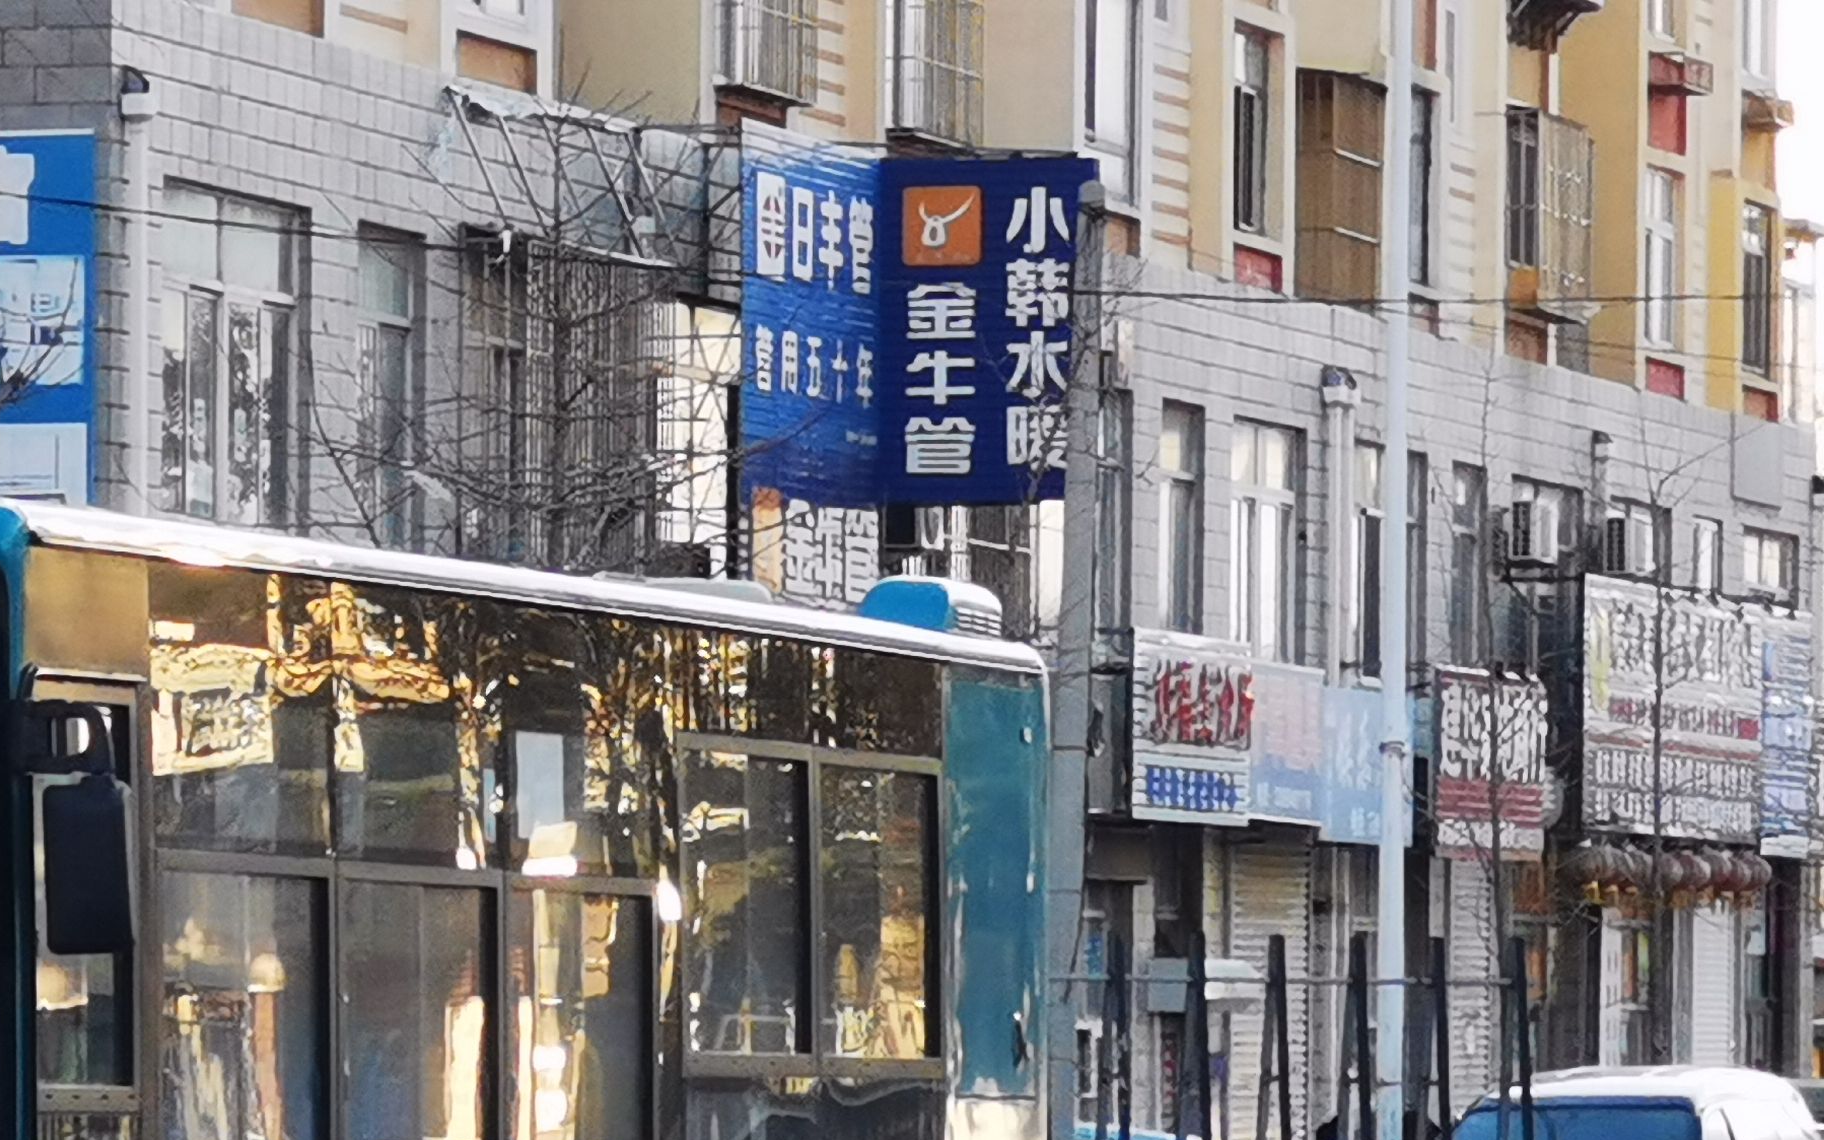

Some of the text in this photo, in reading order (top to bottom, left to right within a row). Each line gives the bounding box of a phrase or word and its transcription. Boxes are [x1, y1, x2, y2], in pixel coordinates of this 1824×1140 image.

[905, 282, 976, 474] 金牛管
[1006, 187, 1069, 470] 小韩水暖
